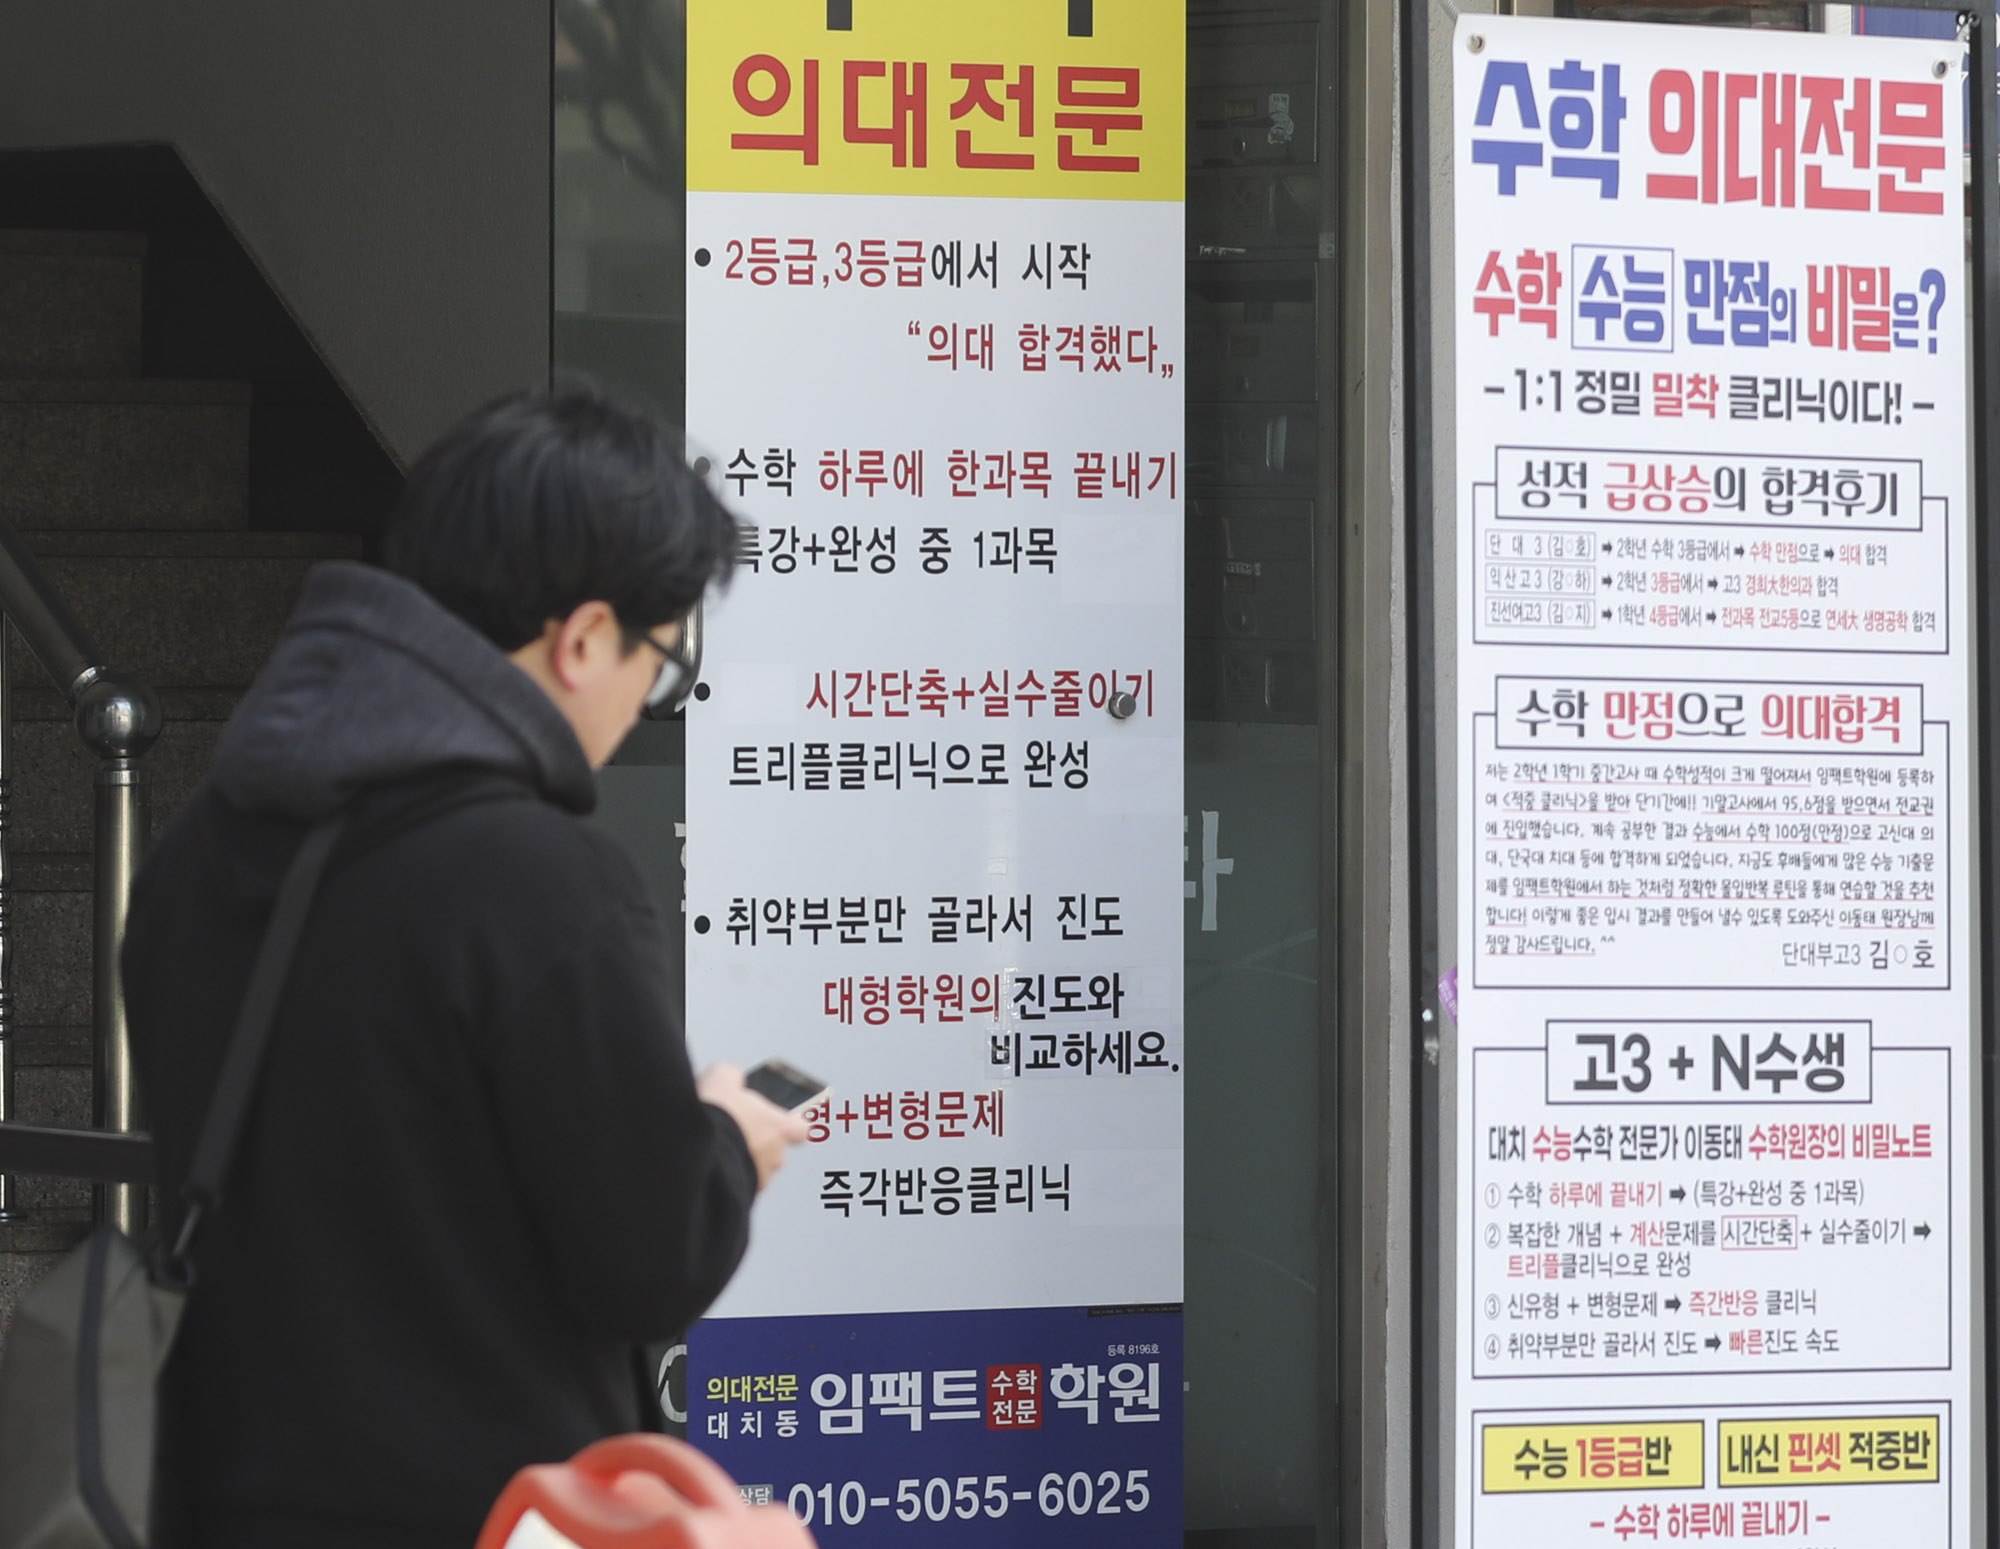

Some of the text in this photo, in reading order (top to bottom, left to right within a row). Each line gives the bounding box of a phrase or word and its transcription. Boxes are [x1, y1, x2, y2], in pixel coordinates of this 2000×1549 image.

[731, 54, 1143, 172] 의대전문
[1472, 60, 1948, 215] 수학 의대전문
[726, 238, 1091, 290] 2등급,3등급에서 시작
[1474, 249, 1946, 354] 수학 수능 만점의 비밀은?
[1576, 370, 1640, 415] 정밀
[1653, 373, 1719, 419] 밀착
[1728, 376, 1902, 425] 클리닉이다!
[725, 448, 1175, 499] 수학 하루에 한과목 끝내기
[1518, 461, 1897, 517] 성적 급상승의 합격후기
[919, 528, 951, 574] 중
[974, 527, 1057, 574] 1과목
[1617, 537, 1646, 559] 2학년
[1651, 538, 1674, 559] 수학
[1678, 539, 1729, 561] 3등급에서
[1750, 541, 1771, 562] 수학
[1776, 542, 1820, 564] 만점으로
[1839, 544, 1861, 565] 의대
[1865, 544, 1887, 566] 합격
[1617, 570, 1646, 592] 2학년
[1652, 572, 1703, 594] 3등급에서
[1723, 575, 1741, 594] 고3
[1817, 576, 1838, 597] 합격
[1490, 601, 1541, 623] 진선여고3
[1618, 604, 1645, 626] 1학년
[1650, 605, 1701, 627] 4등급에서
[1722, 607, 1754, 628] 전과목
[1760, 608, 1821, 630] 전교5등으로
[1826, 610, 1858, 630] 연세大
[1863, 610, 1908, 632] 생명공학
[1912, 611, 1935, 632] 합격
[806, 669, 1155, 718] 시간단축+실수줄이기
[1517, 689, 1899, 743] 수학 만점으로 의대합격
[729, 741, 1088, 791] 트리플클리닉으로 완성
[1486, 762, 1508, 781] 저는
[1514, 763, 1547, 782] 2학년
[1553, 763, 1584, 783] 1학기
[1591, 763, 1639, 783] 중간고사
[1645, 767, 1657, 780] 때
[1663, 765, 1725, 785] 수학성적이
[1732, 766, 1754, 781] 크게
[1817, 767, 1891, 786] 임팩트학원에
[1898, 768, 1934, 787] 등록하
[1486, 793, 1497, 806] 여
[1605, 793, 1630, 812] 받아
[1703, 794, 1776, 813] 기말고사에서
[1842, 796, 1890, 815] 받으면서
[1896, 797, 1933, 816] 전교권
[1486, 820, 1934, 843] 에 진입했습니다. 계속 공부한 결과 수능에서 수학 100점(만점)으로 고신대 의
[726, 893, 1123, 946] 취약부분만 골라서 진도
[1486, 935, 1510, 955] 정말
[1515, 935, 1595, 955] 감사드립니다.
[1783, 942, 1861, 967] 단대부고3
[823, 973, 1125, 1025] 대형학원의 진도와
[990, 1032, 1180, 1077] 비교하세요.
[1574, 1033, 1652, 1093] 고3
[1713, 1032, 1845, 1094] N수생
[1489, 1124, 1932, 1162] 대치 수능수학 전문가 이동태 수학원장의 비밀노트
[821, 1164, 1069, 1217] 즉각반응클리닉
[1507, 1182, 1542, 1208] 수학
[1549, 1182, 1602, 1208] 하루에
[1610, 1181, 1661, 1207] 끝내기
[1694, 1180, 1782, 1208] (특강+완성
[1789, 1181, 1806, 1206] 중
[1815, 1179, 1864, 1205] 1과목)
[1507, 1221, 1560, 1248] 복잡한
[1568, 1222, 1601, 1247] 개념
[1630, 1220, 1716, 1247] 계산문제를
[1724, 1218, 1795, 1247] 시간단축
[1820, 1218, 1905, 1245] 실수줄이기
[1508, 1251, 1690, 1279] 트리플클리닉으로 완성
[1508, 1292, 1559, 1319] 신유형
[1588, 1292, 1657, 1318] 변형문제
[1689, 1290, 1758, 1316] 즉간반응
[1766, 1289, 1816, 1315] 클리닉
[1108, 1344, 1160, 1356] 등록 8196호
[1508, 1332, 1596, 1359] 취약부분만
[1603, 1331, 1655, 1357] 골라서
[1664, 1331, 1697, 1356] 진도
[1729, 1329, 1798, 1355] 빠른진도
[1805, 1328, 1839, 1354] 속도
[707, 1374, 799, 1405] 의대전문
[811, 1363, 1160, 1434] 임팩트 학원
[992, 1368, 1038, 1396] 수학
[992, 1399, 1038, 1425] 전문
[1514, 1436, 1672, 1479] 수능 1등급반
[1727, 1430, 1931, 1474] 내신 핀셋 적중반
[787, 1469, 1151, 1528] 010-5055-6025
[1614, 1500, 1807, 1541] 수학 하루에 끝내기
